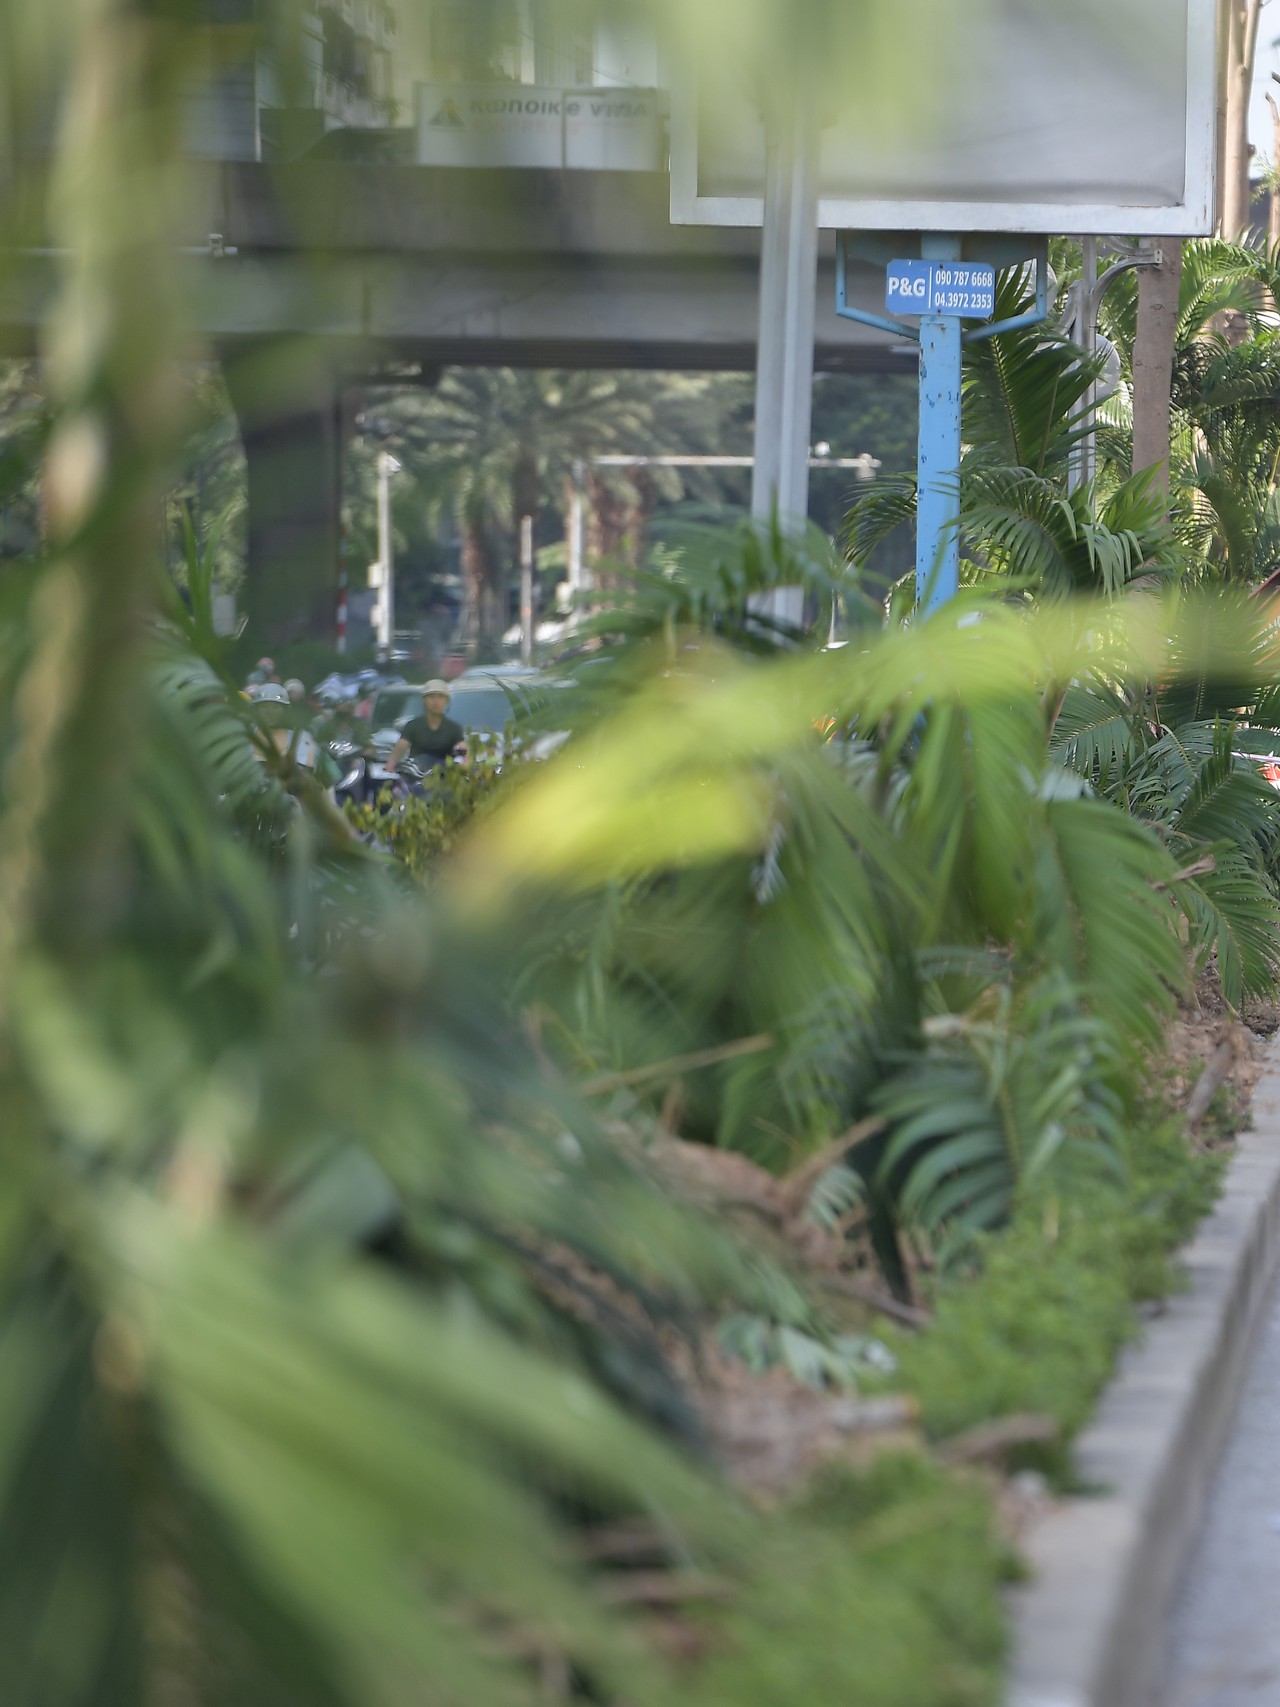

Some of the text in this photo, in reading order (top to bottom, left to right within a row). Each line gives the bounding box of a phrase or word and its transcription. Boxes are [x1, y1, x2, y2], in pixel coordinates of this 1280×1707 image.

[888, 276, 926, 297] P&G
[935, 270, 993, 287] 090 787 6668
[934, 292, 992, 309] 04.3972 2353
